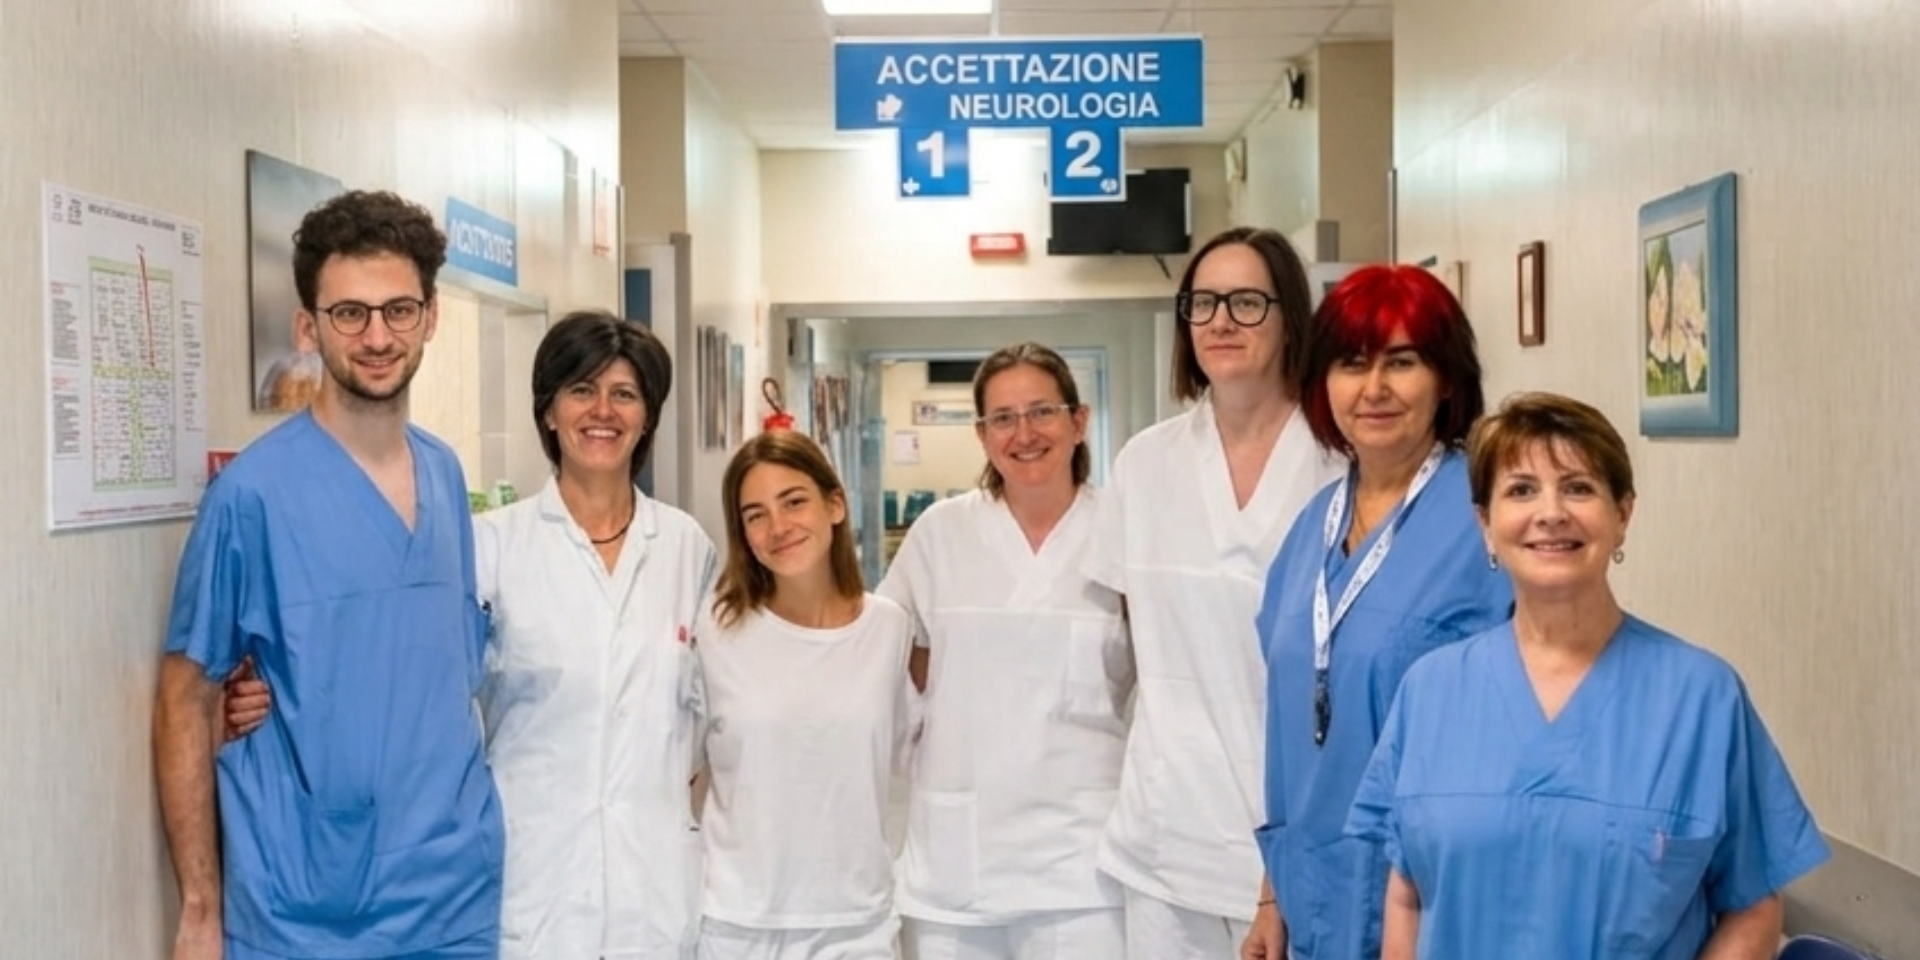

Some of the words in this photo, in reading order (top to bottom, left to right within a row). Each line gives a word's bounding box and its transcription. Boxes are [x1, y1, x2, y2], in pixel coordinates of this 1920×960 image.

[877, 53, 1159, 85] ACCETTAZIONE
[950, 92, 1159, 119] NEUROLOGIA
[917, 131, 946, 178] 1
[1065, 131, 1102, 178] 2
